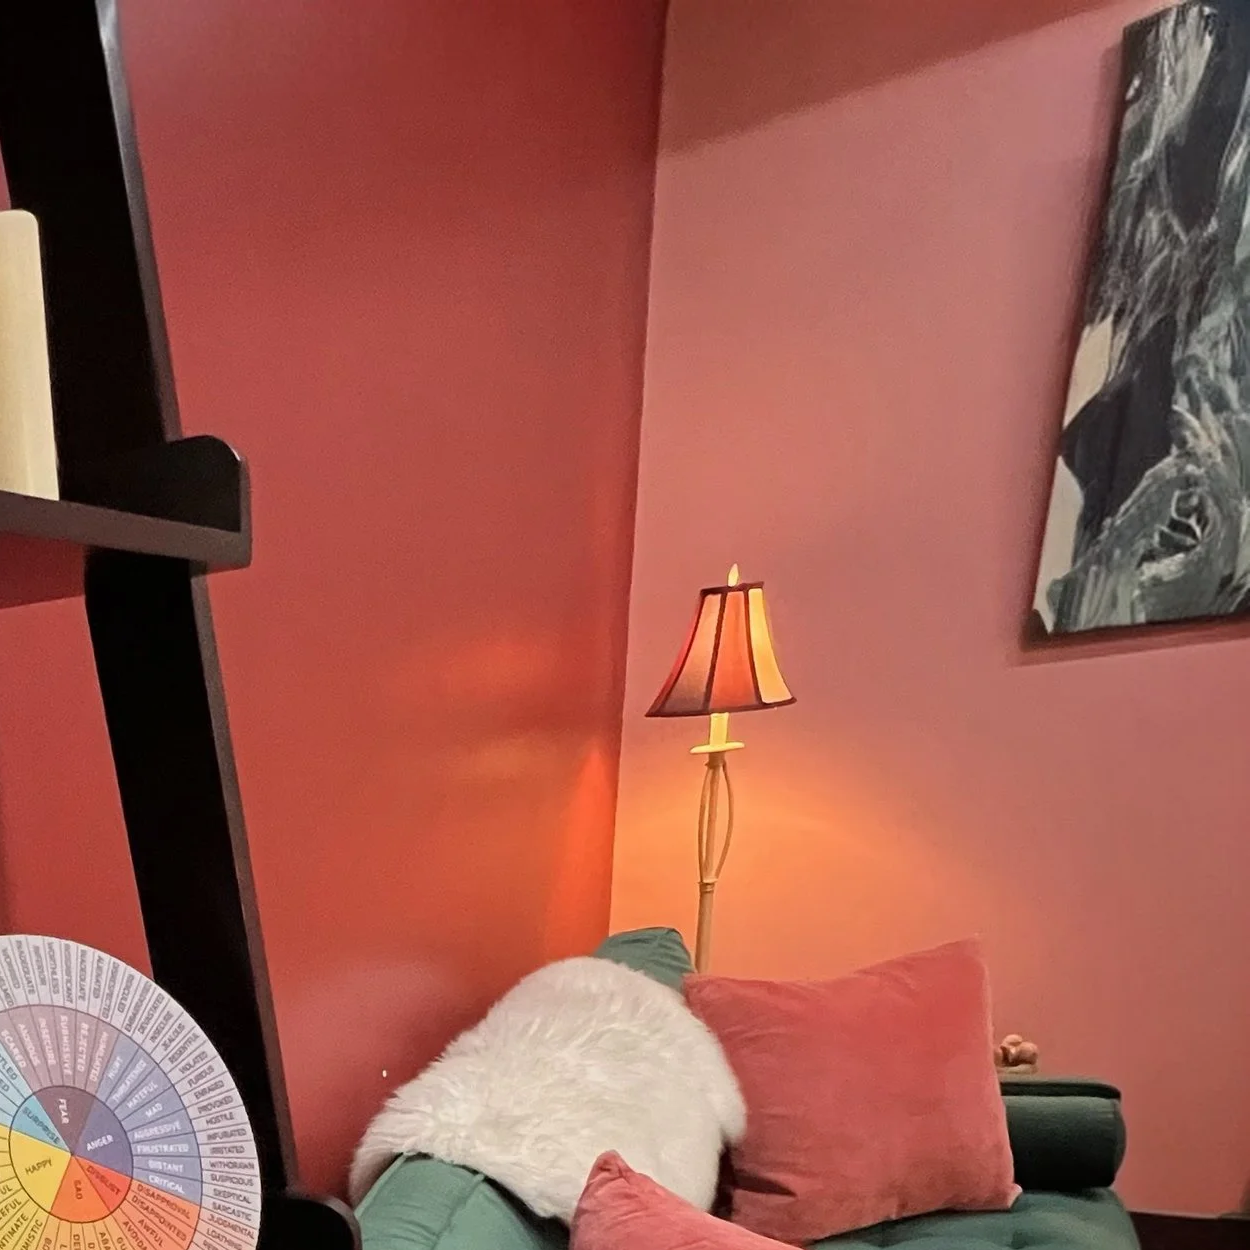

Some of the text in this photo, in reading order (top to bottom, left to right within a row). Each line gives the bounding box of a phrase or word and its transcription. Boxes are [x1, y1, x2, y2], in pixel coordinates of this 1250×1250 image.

[138, 992, 165, 1035] DEVASTATED
[39, 1017, 56, 1065] INSECURE
[60, 1015, 71, 1076] SUBMISSIVE
[78, 1022, 89, 1072] REJECTED
[162, 1023, 185, 1051] JEALOUS
[168, 1032, 199, 1064] RESENTFUL
[1, 1030, 26, 1069] SCARED
[108, 1056, 123, 1080] HURT
[179, 1051, 207, 1074] VIOLATED
[113, 1059, 147, 1101] THREATENED
[187, 1065, 214, 1088] FURIOUS
[127, 1081, 158, 1108] HATEFUL
[198, 1096, 233, 1114] PROVOKED
[58, 1098, 69, 1124] FEAR
[145, 1103, 163, 1118] MAD
[206, 1112, 235, 1125] HOSTILE
[22, 1106, 60, 1144] SURPRISE
[134, 1121, 181, 1139] AGGRESSIVE
[87, 1135, 113, 1151] ANGER
[136, 1144, 189, 1153] FRUSTRATED
[25, 1159, 52, 1176] HAPPY
[149, 1160, 184, 1173] DISTANT
[209, 1161, 254, 1170] WITHDRAWN
[74, 1180, 83, 1200] SAD
[86, 1166, 121, 1196] DISGUST
[149, 1175, 184, 1194] CRITICAL
[211, 1174, 254, 1186] SUSPICIOUS
[137, 1184, 190, 1219] DISAPPROVAL
[213, 1189, 251, 1204] SKEPTICAL
[132, 1195, 186, 1241] DISAPPOINTED
[213, 1202, 252, 1221] SARCASTIC
[138, 1219, 164, 1247] AWFUL
[207, 1227, 242, 1250] LOATHING
